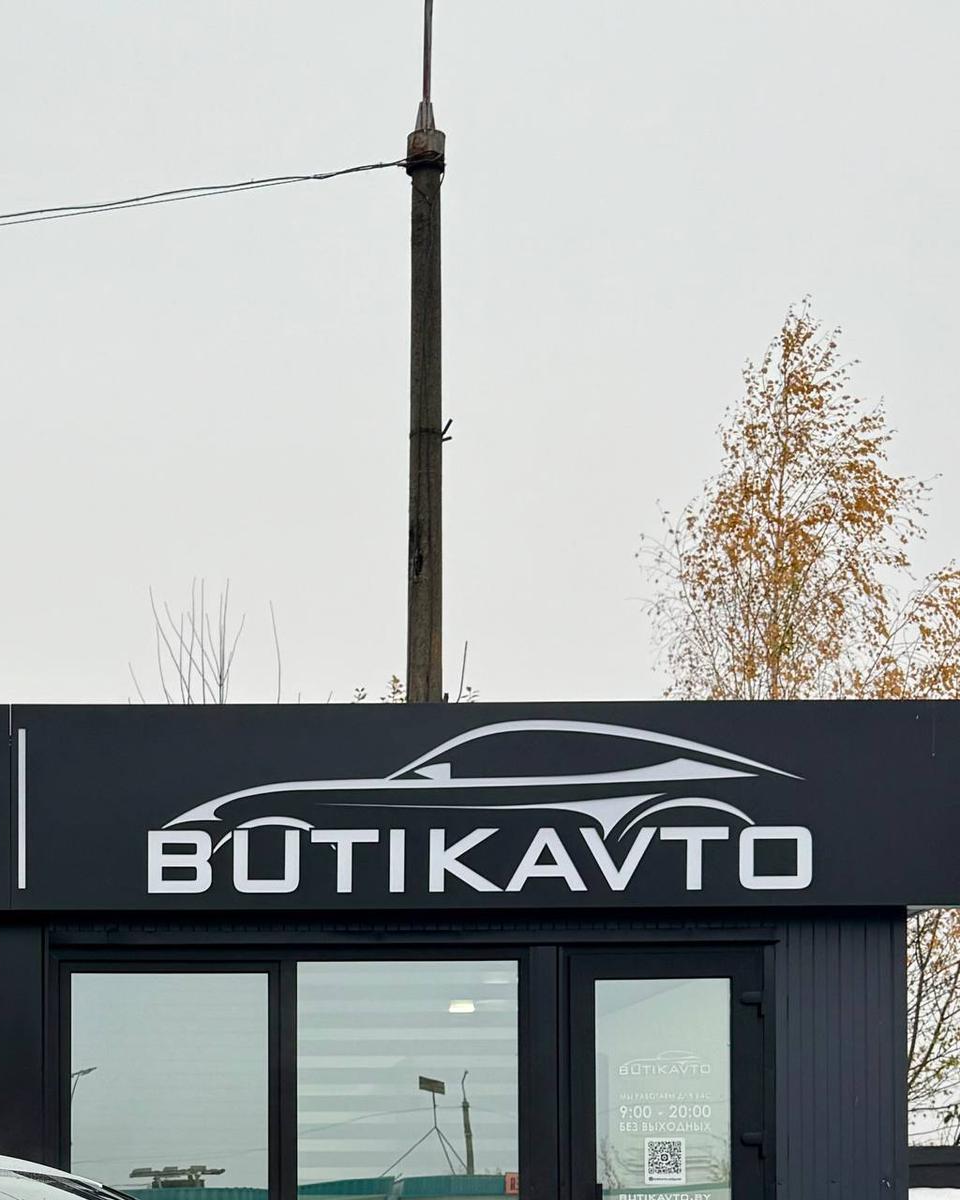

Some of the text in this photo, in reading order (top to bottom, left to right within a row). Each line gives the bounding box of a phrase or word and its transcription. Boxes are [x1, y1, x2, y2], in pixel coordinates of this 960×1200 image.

[147, 824, 813, 895] BUTIKAVTO
[619, 1063, 711, 1075] BUTIKAVTO
[620, 1105, 652, 1119] 9:00
[669, 1104, 712, 1118] 20:00
[619, 1121, 711, 1132] БЕЗ ВЫХОДНЫХ
